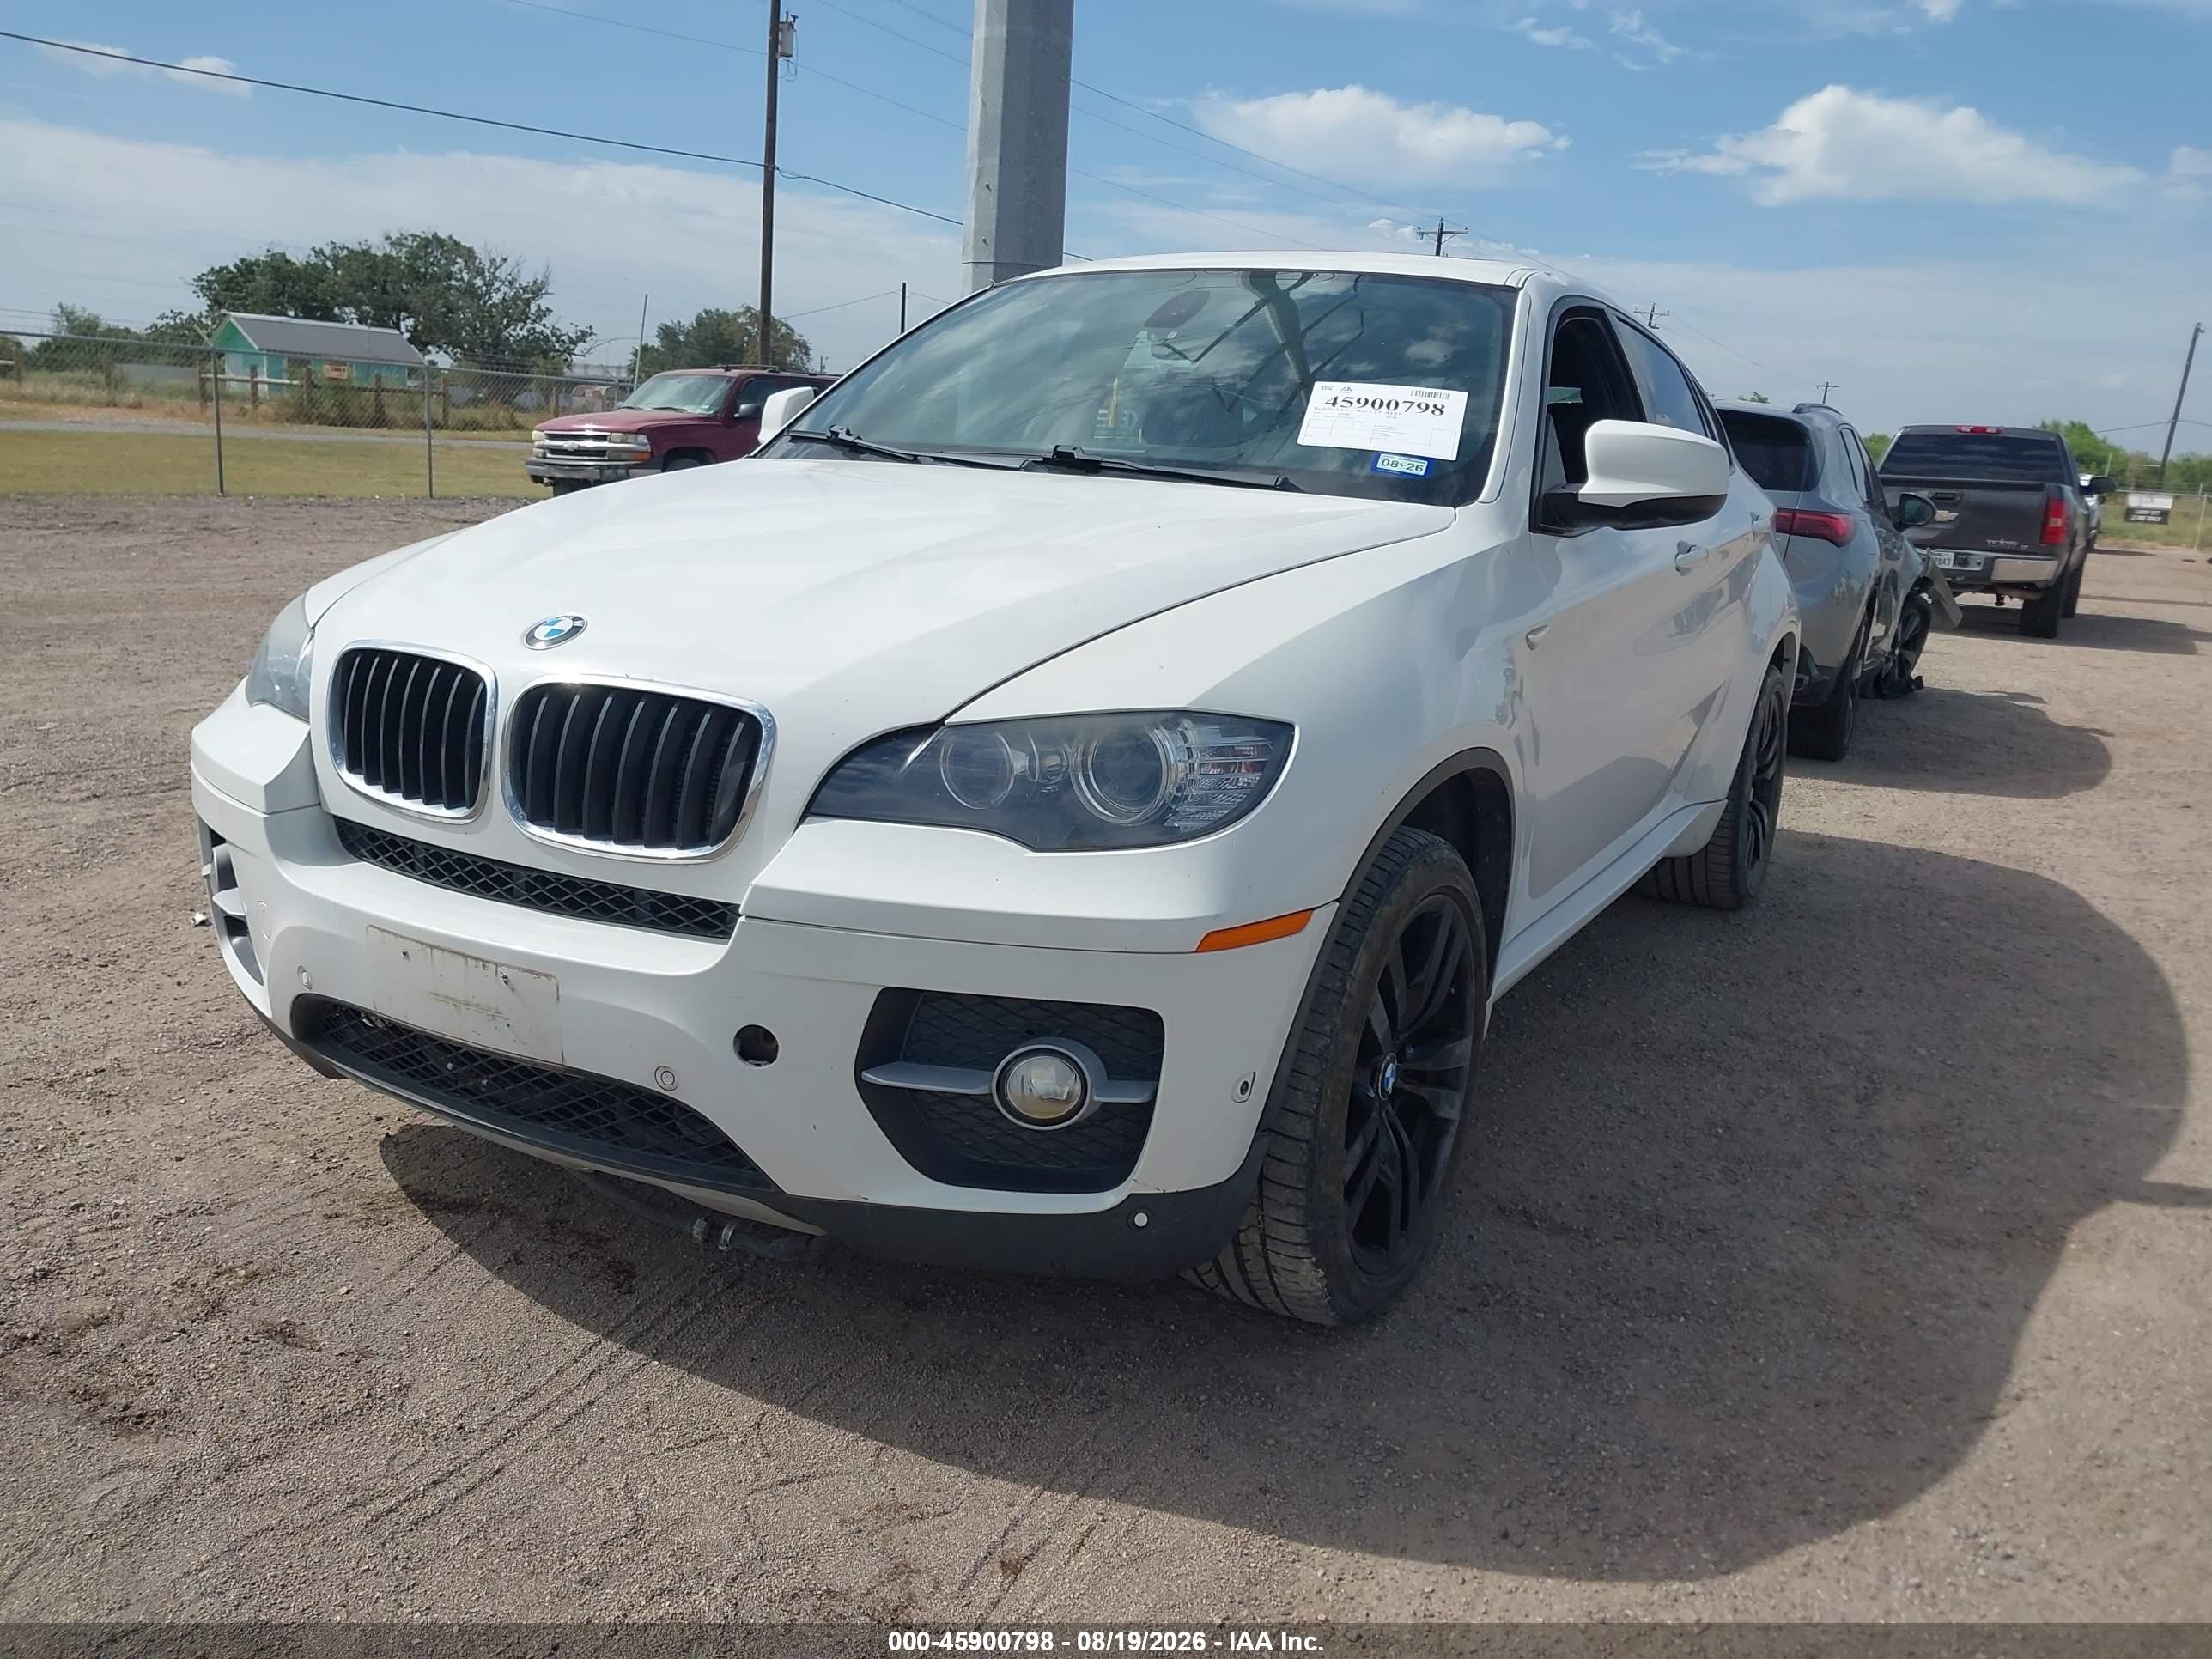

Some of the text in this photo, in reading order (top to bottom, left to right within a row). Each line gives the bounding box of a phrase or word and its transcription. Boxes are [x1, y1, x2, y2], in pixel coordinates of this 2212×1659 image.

[1325, 395, 1445, 416] 45900798
[1381, 459, 1424, 472] 08 26
